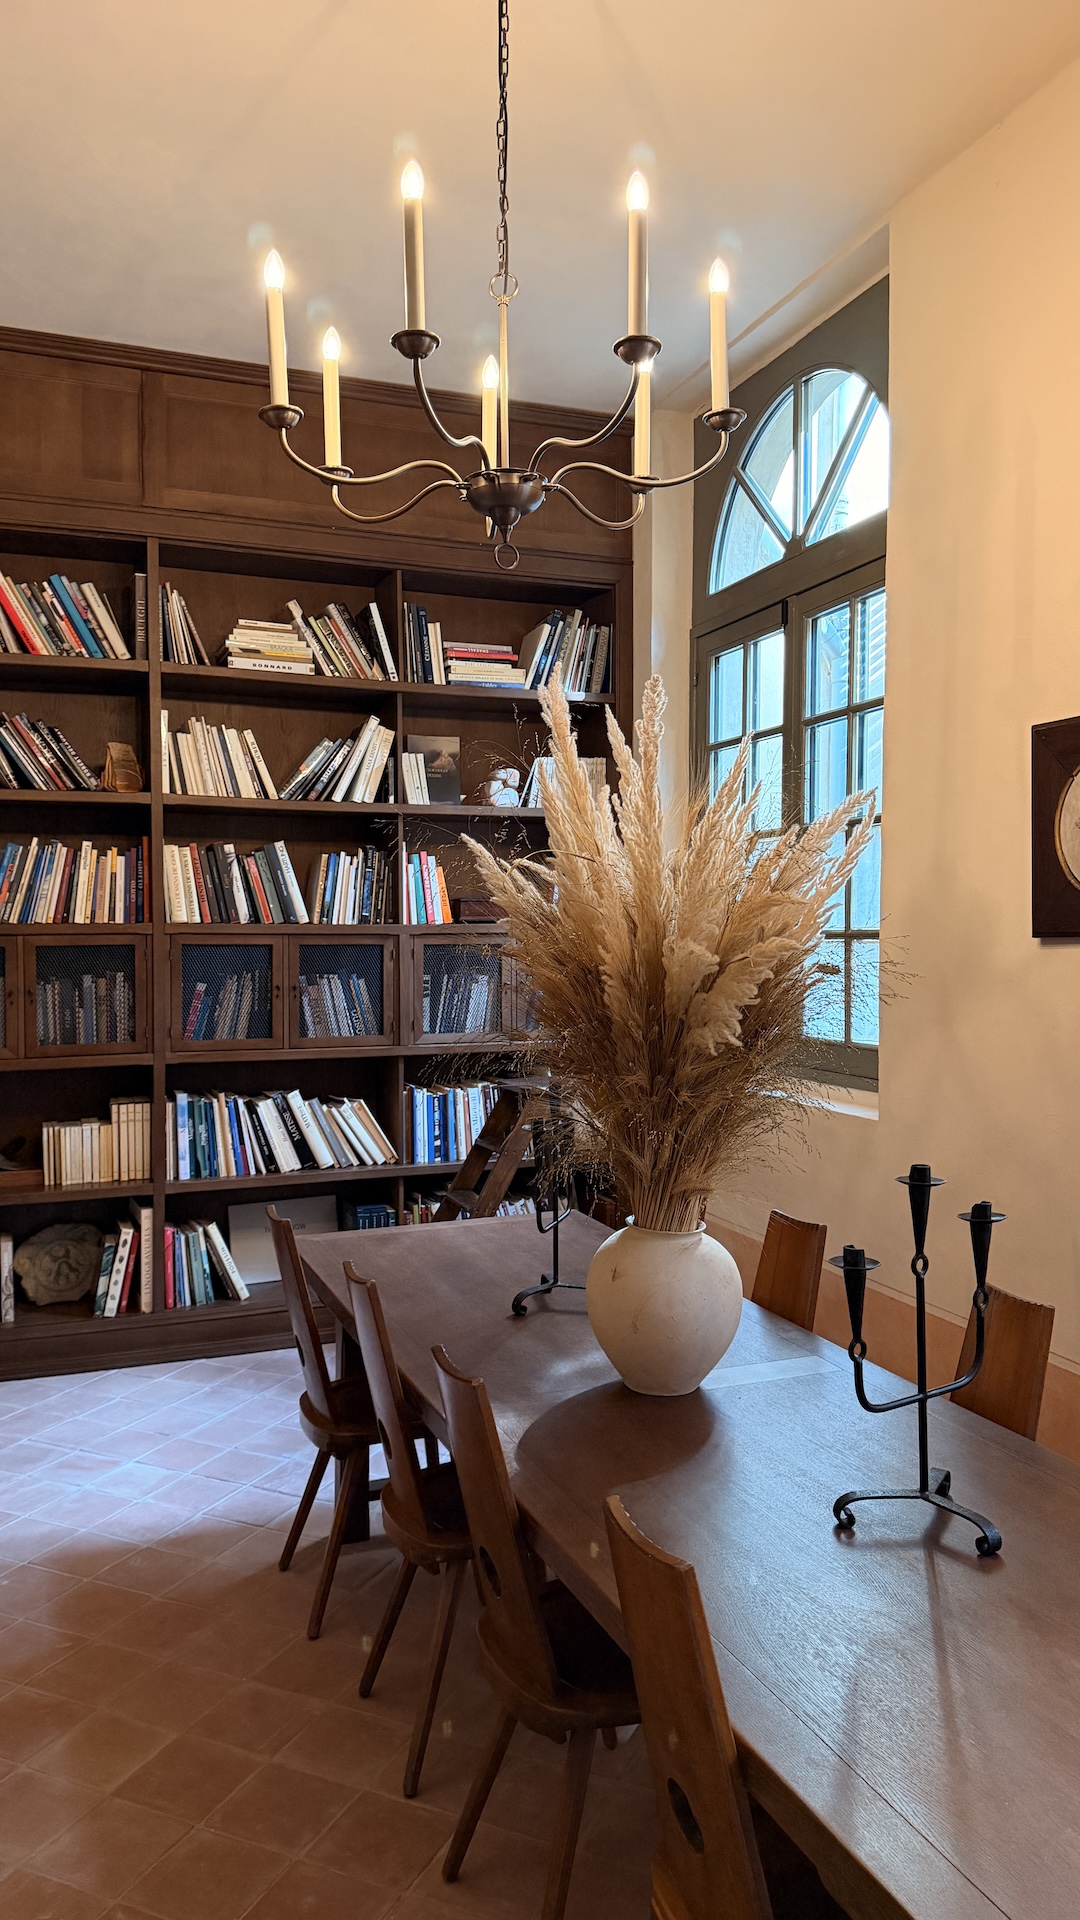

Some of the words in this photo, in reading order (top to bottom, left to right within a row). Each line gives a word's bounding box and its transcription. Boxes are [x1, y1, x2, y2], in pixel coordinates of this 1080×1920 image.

[137, 598, 145, 641] BRUEGEL
[20, 629, 35, 651] BOTERO
[269, 644, 293, 652] BRAQUE
[36, 718, 60, 749] DELACROIX
[53, 726, 76, 756] DELAUNAY
[30, 731, 57, 764] DEGAS
[368, 742, 378, 759] ERNST
[73, 754, 92, 777] ROBERT
[320, 761, 338, 784] Ernst
[365, 758, 373, 771] MAX
[81, 844, 90, 870] Gauguin
[182, 859, 190, 872] GOYA
[193, 857, 202, 880] GOETZ
[277, 844, 291, 874] HARTUNG
[185, 875, 191, 883] DE
[197, 880, 206, 902] HENRI
[186, 883, 195, 906] DESSINS
[425, 889, 433, 914] INDIANA
[296, 1103, 312, 1129] MATISSE
[470, 1096, 478, 1125] Mitchell
[186, 1117, 194, 1141] Magritte
[281, 1109, 301, 1141] MATISSE
[144, 1227, 153, 1296] LINOGRAVURES
[220, 1246, 236, 1274] POUSSIN
